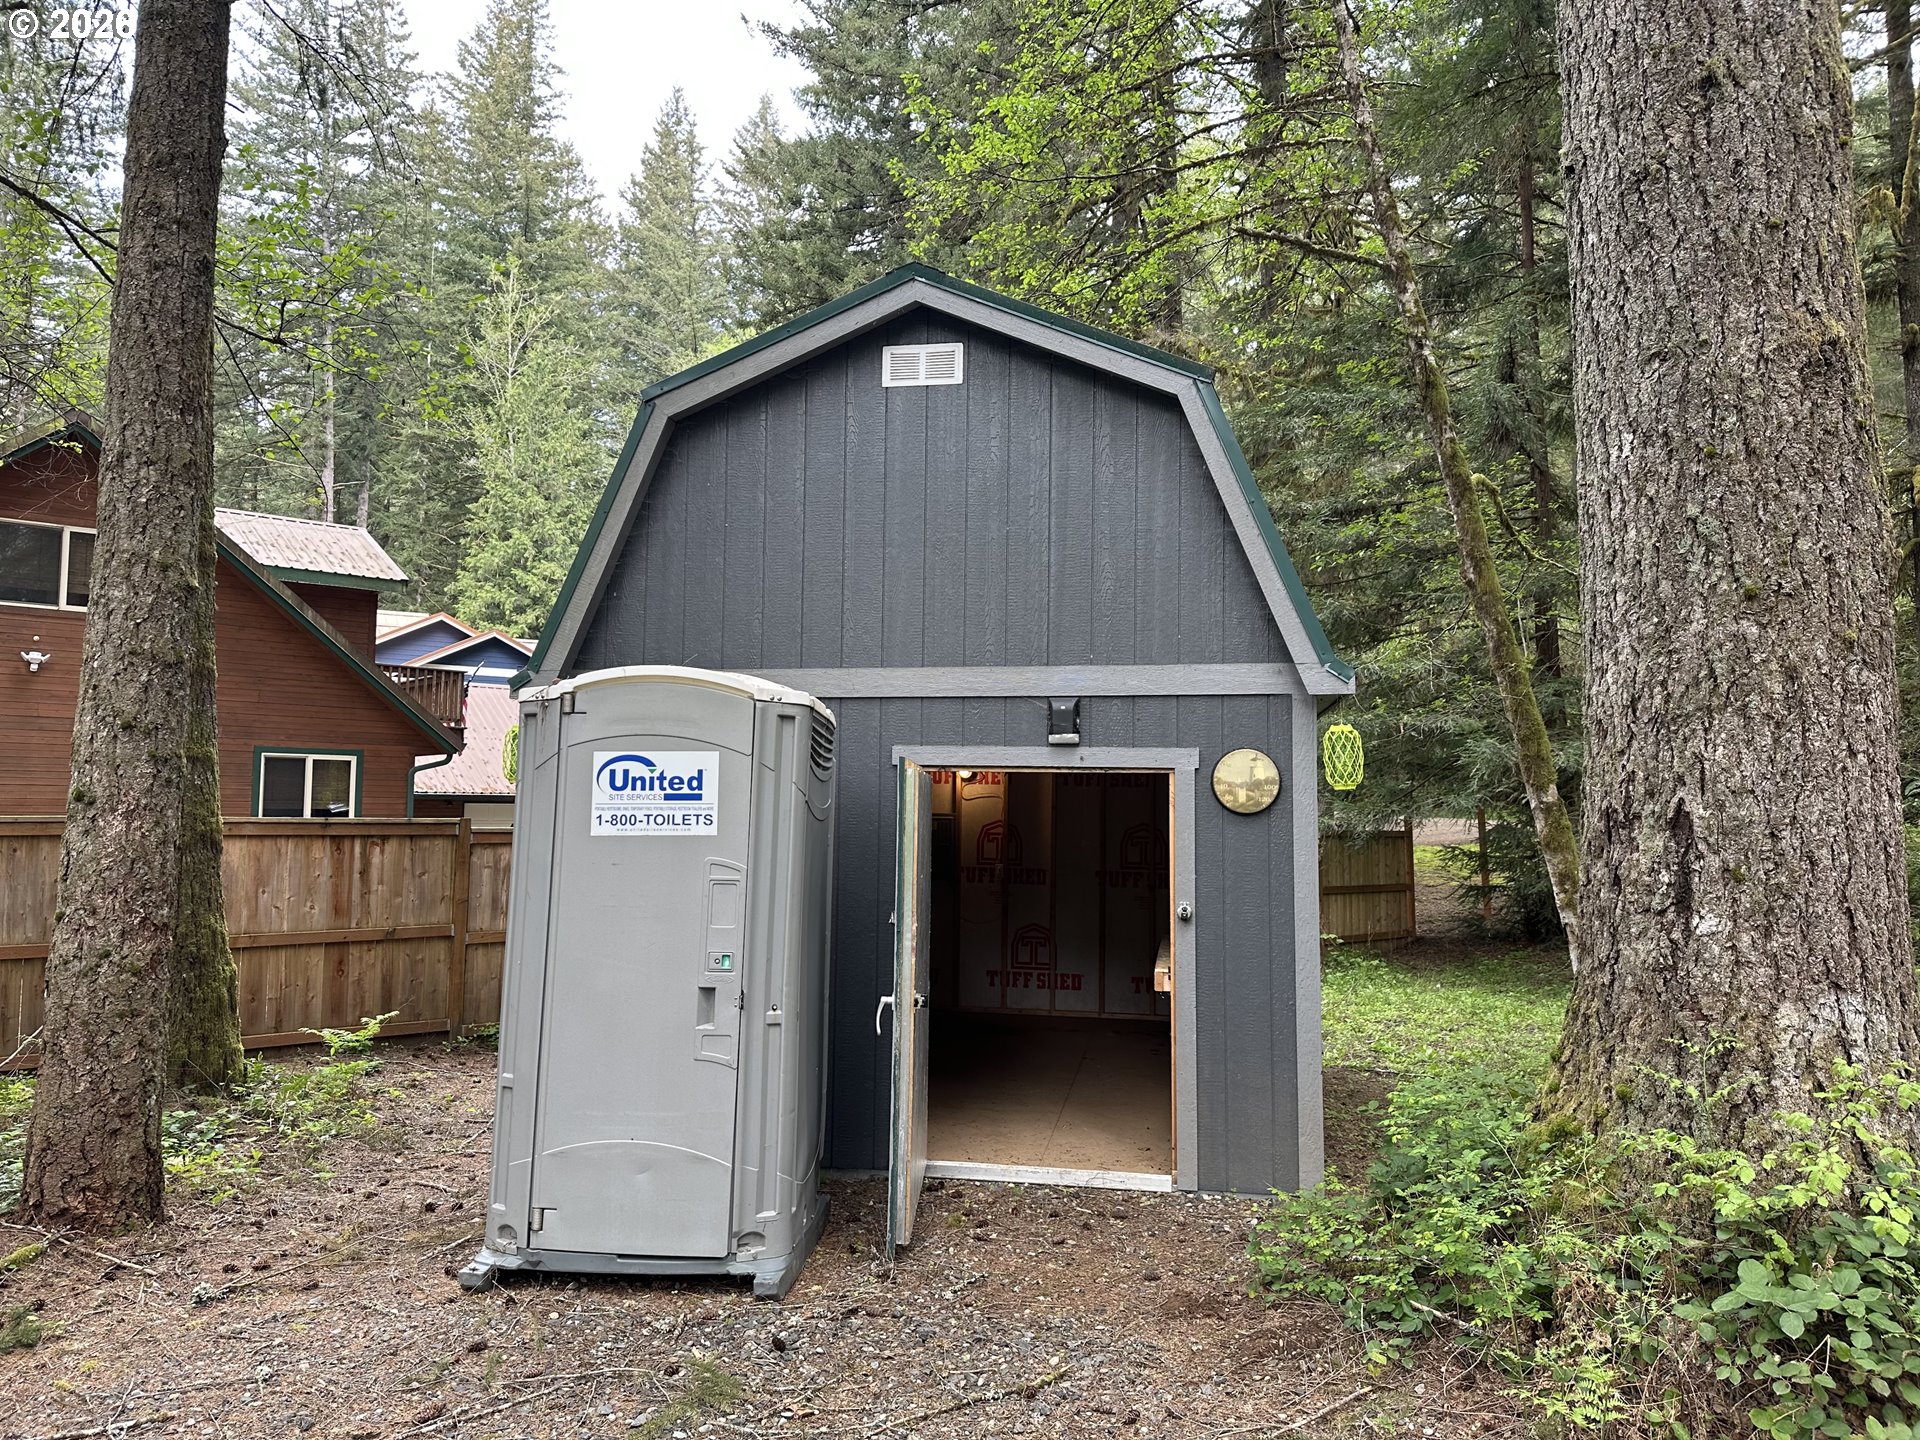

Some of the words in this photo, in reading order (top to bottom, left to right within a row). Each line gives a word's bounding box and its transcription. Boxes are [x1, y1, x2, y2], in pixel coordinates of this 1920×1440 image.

[609, 769, 703, 791] United
[608, 793, 625, 801] SITE
[626, 793, 663, 801] SERVICES
[595, 814, 714, 826] 1-800-TOILETS
[986, 970, 1033, 988] TUFF
[1036, 972, 1082, 990] SHED
